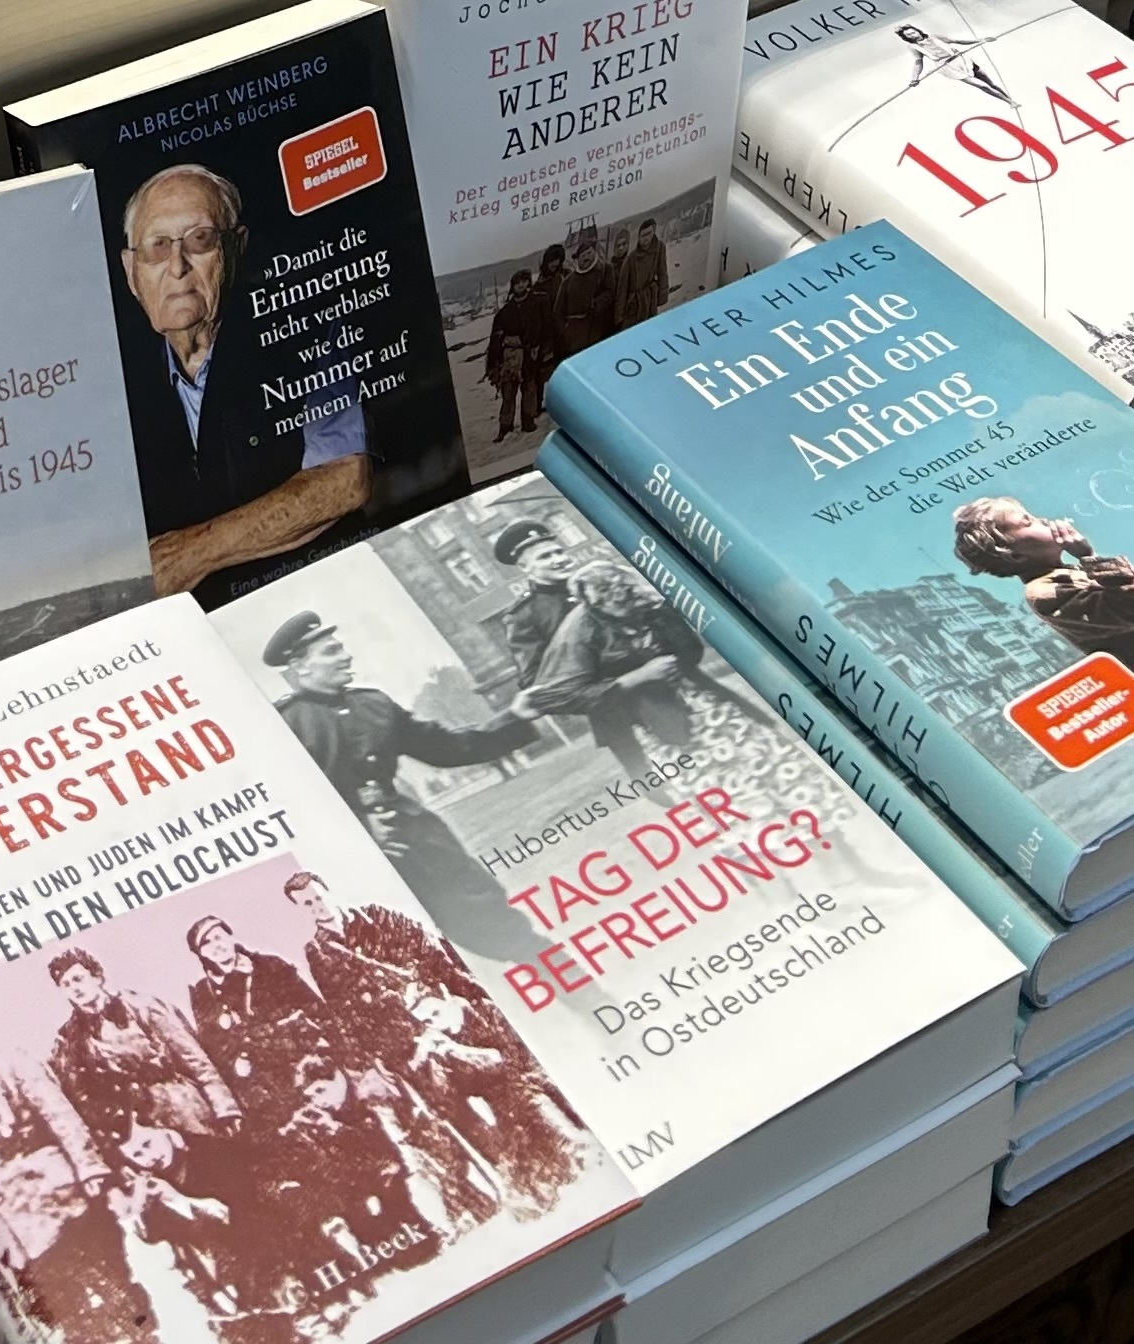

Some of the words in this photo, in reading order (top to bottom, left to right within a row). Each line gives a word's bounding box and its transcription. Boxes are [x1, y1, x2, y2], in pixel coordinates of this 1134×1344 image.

[117, 93, 221, 144] ALBRECHT
[225, 54, 330, 108] WEINBERG
[488, 31, 558, 80] EIN
[497, 70, 569, 119] WIE
[589, 32, 681, 90] KEIN
[160, 117, 234, 153] NICOLAS
[236, 91, 299, 126] BÜCHSE
[303, 134, 360, 172] SPIEGEL
[501, 77, 670, 161] ANDERER
[896, 55, 1134, 219] 1945
[302, 152, 370, 192] Bestseller
[248, 248, 392, 319] Erinnerung
[258, 312, 310, 348] nicht
[314, 280, 392, 324] verblasst
[614, 305, 754, 382] OLIVER
[768, 243, 899, 312] HILMES
[260, 347, 374, 411] Nummer
[378, 329, 412, 365] auf
[297, 337, 332, 365] wie
[336, 324, 366, 353] die
[674, 354, 788, 411] Ein
[769, 288, 919, 364] Ende
[789, 354, 888, 414] und
[883, 322, 961, 372] ein
[29, 438, 95, 484] 1945
[789, 371, 998, 482] Anfang
[907, 486, 940, 518] die
[939, 462, 987, 499] Welt
[985, 413, 1098, 476] veränderte
[812, 497, 862, 529] Wie
[864, 477, 903, 507] der
[903, 434, 991, 486] Sommer
[987, 419, 1016, 446] 45
[1035, 672, 1106, 720] SPIEGEL
[33, 862, 83, 901] UND
[84, 830, 158, 880] JUDEN
[161, 817, 191, 847] IM
[192, 781, 272, 834] KAMPF
[477, 793, 611, 879] Hubertus
[607, 749, 699, 808] Knabe
[507, 849, 634, 932] TAG
[626, 785, 752, 872] DER
[46, 888, 114, 943] DEN
[115, 808, 298, 911] HOLOCAUST
[504, 808, 834, 1014] BEFREIUNG?
[592, 989, 662, 1038] Das
[660, 887, 839, 1009] Kriegsende
[600, 1044, 642, 1083] in
[641, 904, 887, 1059] Ostdeutschland
